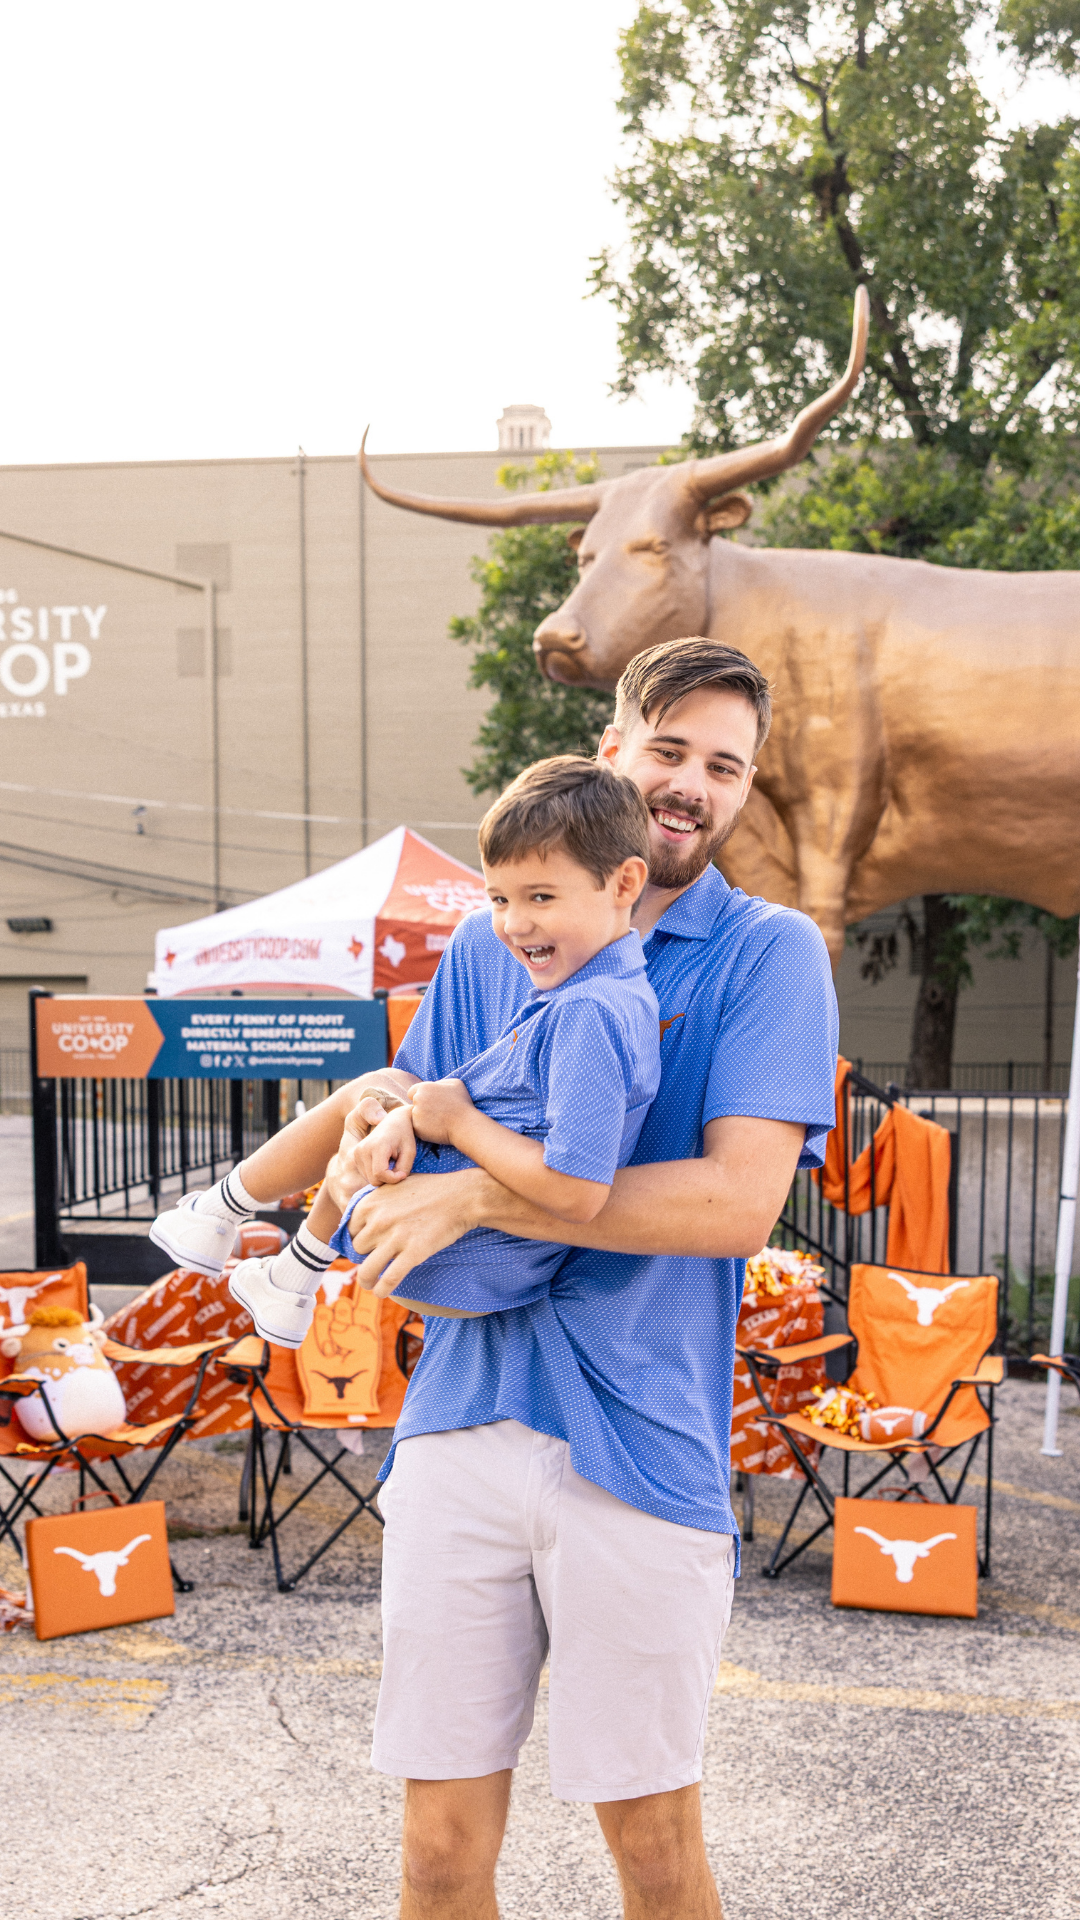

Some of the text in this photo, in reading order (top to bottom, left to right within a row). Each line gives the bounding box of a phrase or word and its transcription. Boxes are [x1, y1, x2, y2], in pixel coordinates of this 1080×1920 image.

[190, 1014, 345, 1026] EVERY PENNY OF PROFIT
[51, 1022, 134, 1035] UNIVERSITY
[181, 1027, 356, 1039] DIRECTLY BENEFITS COURSE
[186, 1041, 351, 1052] MATERIAL SCHOLARSHIPS!
[248, 1055, 325, 1067] @universitycoop
[741, 1307, 780, 1333] TEXAS
